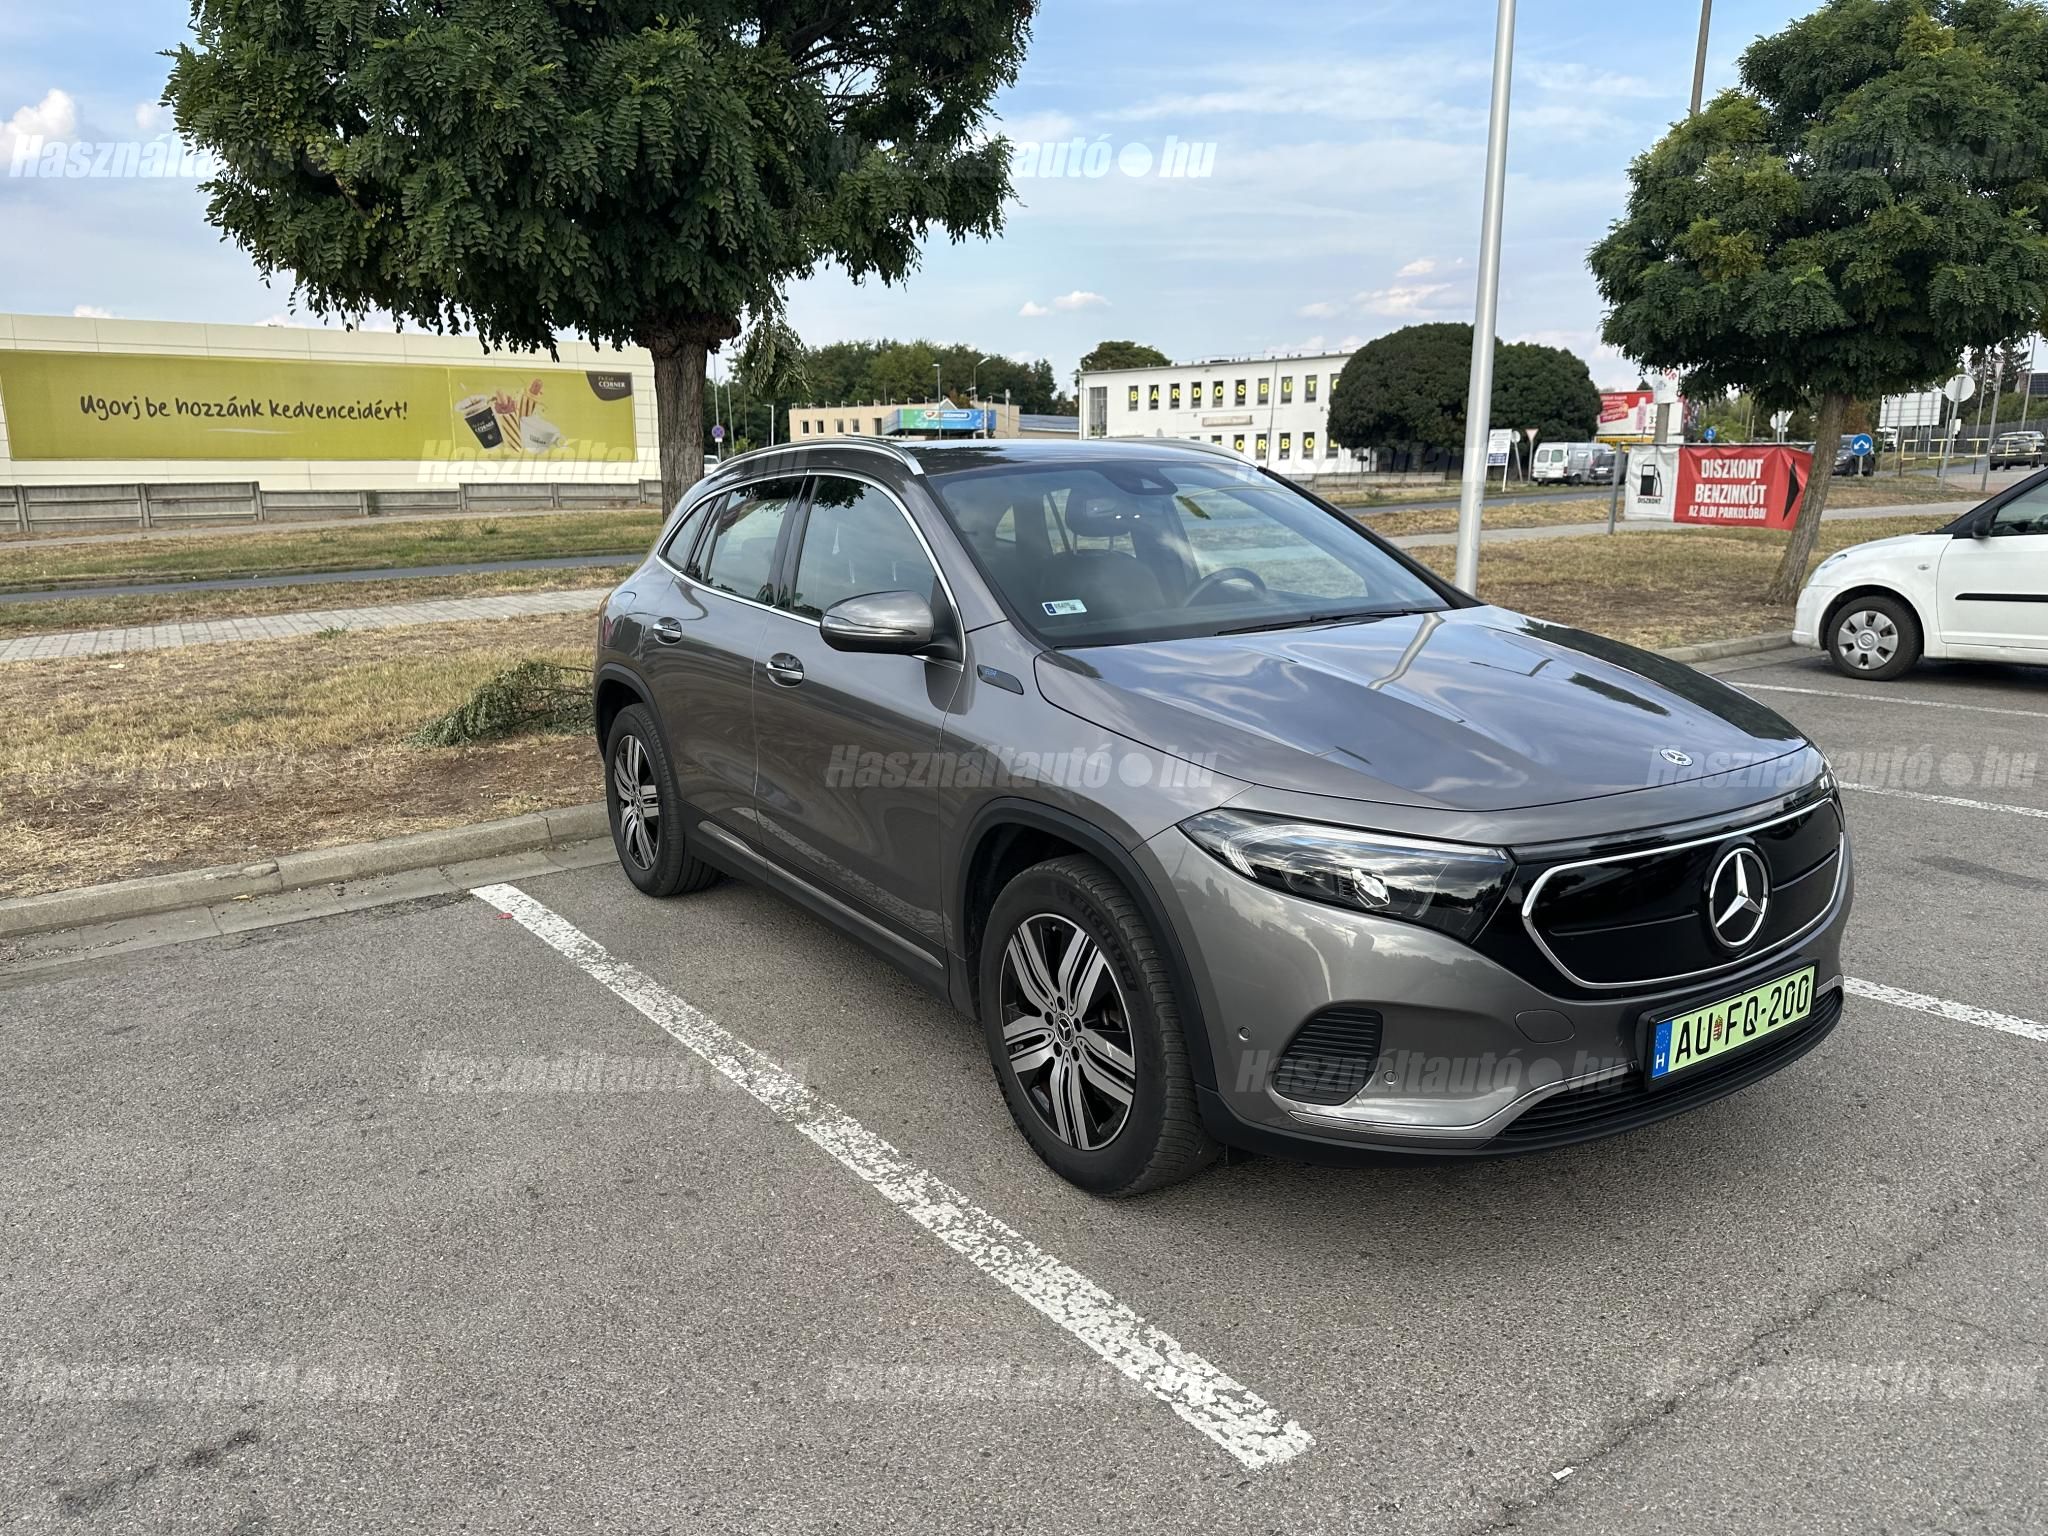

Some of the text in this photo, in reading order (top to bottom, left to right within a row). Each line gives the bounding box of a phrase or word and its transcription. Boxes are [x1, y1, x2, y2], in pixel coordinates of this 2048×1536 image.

[80, 394, 408, 421] Ugorj be hozzánk kedvenceidért!
[1701, 459, 1764, 479] DISZKONT
[1695, 481, 1768, 504] BENZINKÚT
[1688, 505, 1699, 517] AZ
[1699, 506, 1717, 518] ALDI
[1655, 1052, 1665, 1070] H
